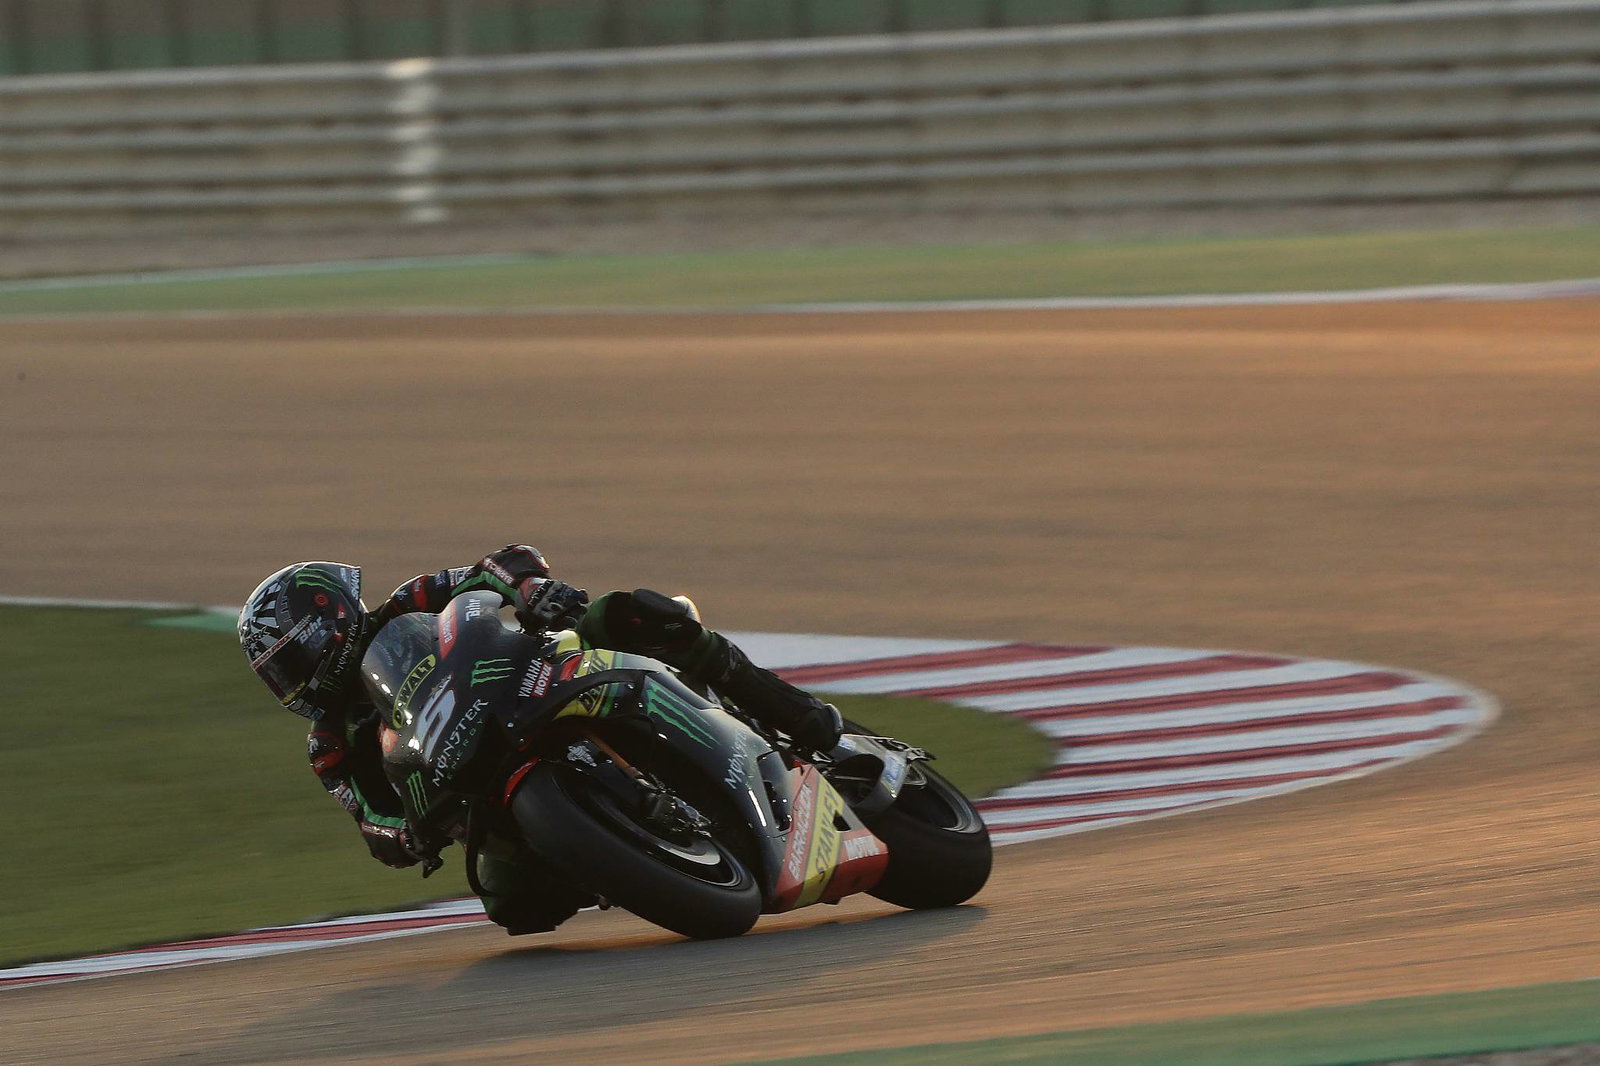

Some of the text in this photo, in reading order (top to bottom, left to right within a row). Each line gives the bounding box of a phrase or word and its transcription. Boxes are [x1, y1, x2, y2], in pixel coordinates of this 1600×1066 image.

[465, 598, 481, 622] Bihr
[518, 658, 542, 698] YAMAHA
[534, 664, 553, 697] MOTUL
[432, 699, 489, 787] MONSTER
